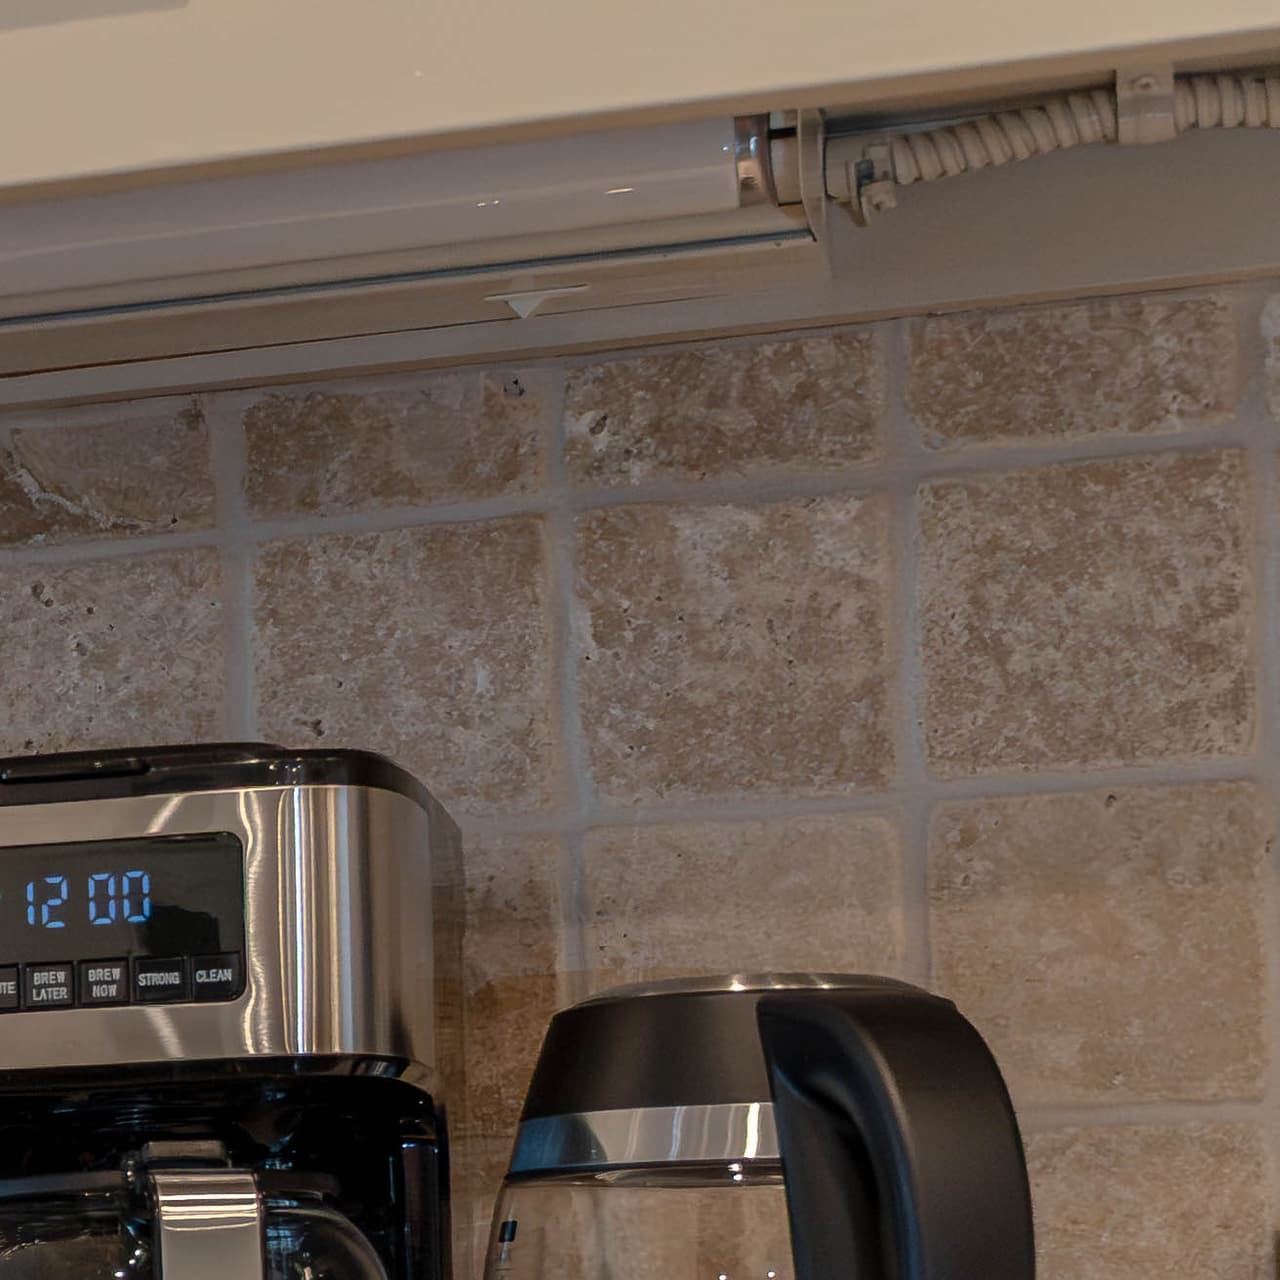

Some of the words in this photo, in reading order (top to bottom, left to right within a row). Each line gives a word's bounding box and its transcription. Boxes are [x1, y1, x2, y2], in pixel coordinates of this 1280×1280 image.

[34, 971, 65, 985] BREW
[88, 968, 120, 981] BREW
[138, 972, 180, 986] STRONG
[195, 969, 232, 983] CLEAN
[32, 987, 68, 1000] LATER
[92, 984, 117, 998] NOW
